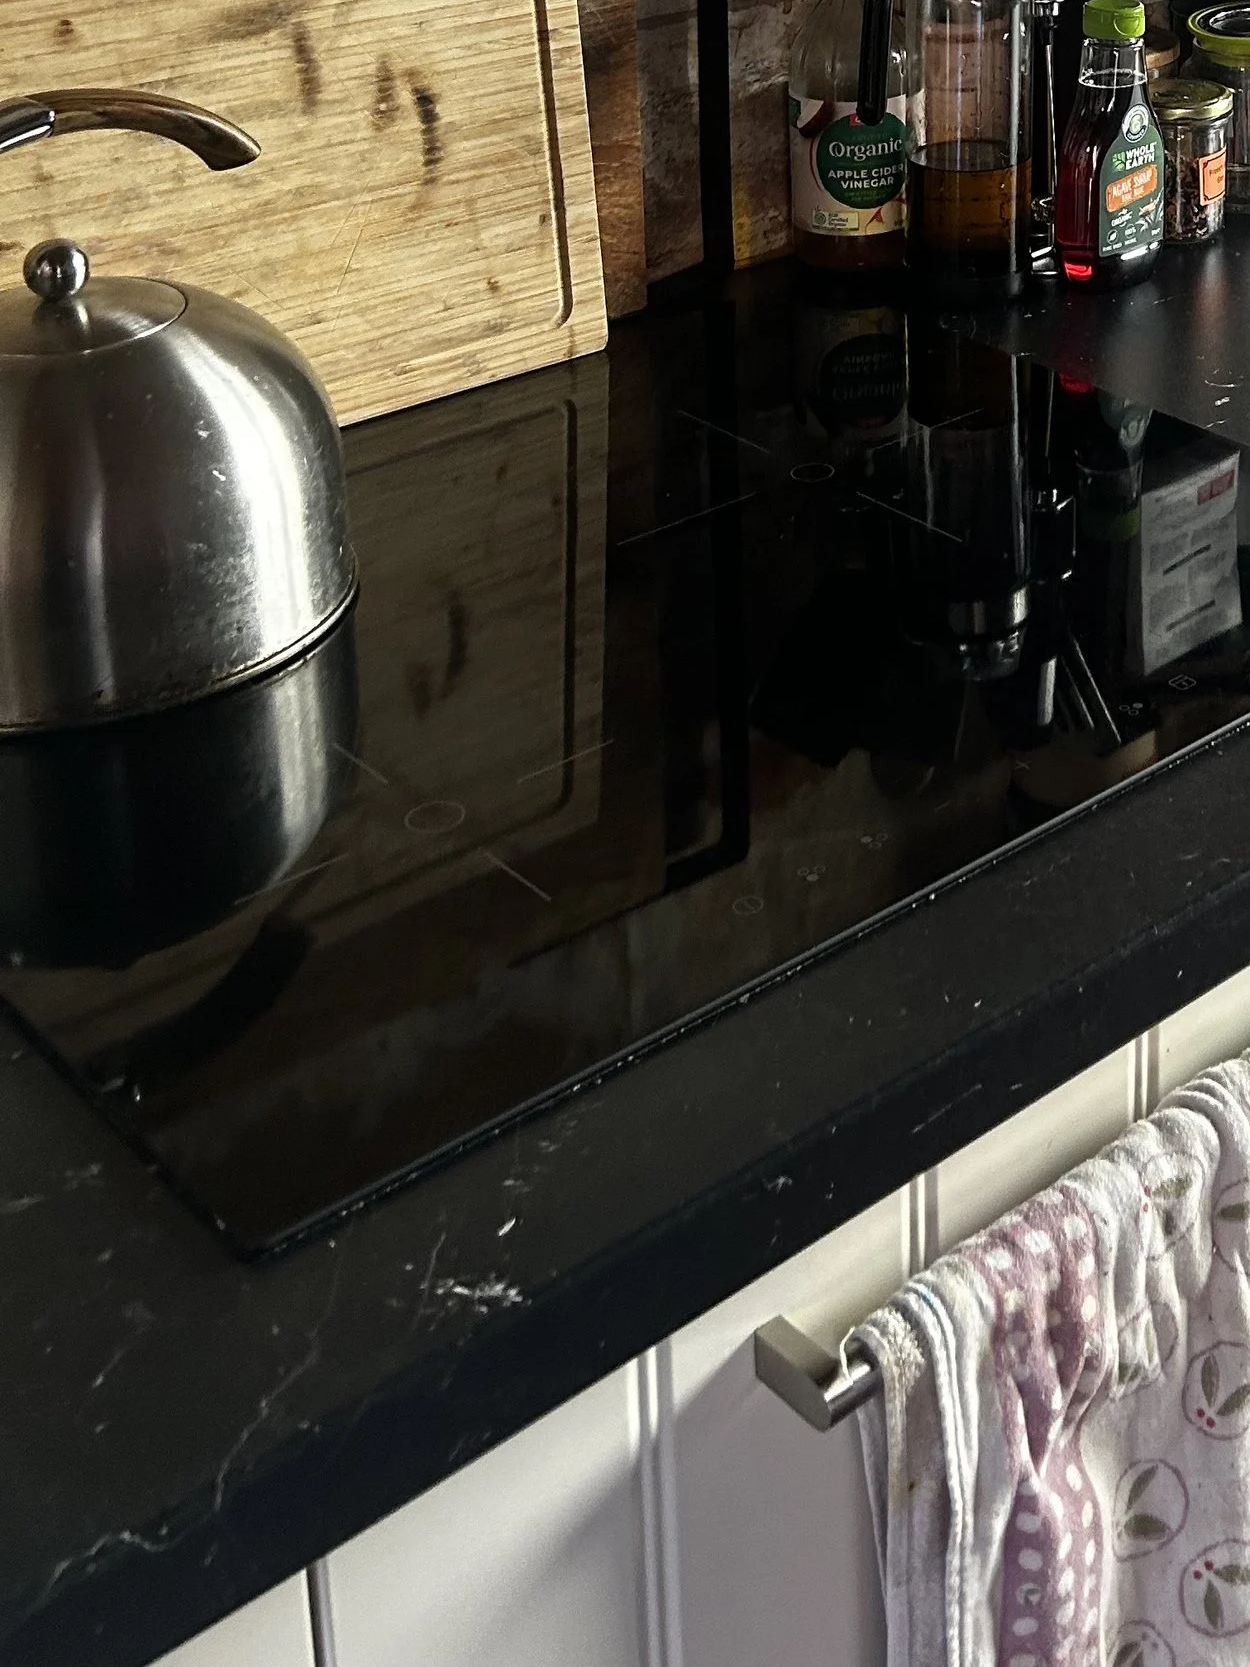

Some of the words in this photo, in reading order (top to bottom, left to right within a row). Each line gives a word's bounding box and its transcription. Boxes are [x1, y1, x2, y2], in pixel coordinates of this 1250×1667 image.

[828, 137, 903, 162] Organic
[1126, 143, 1155, 160] WHOLE
[1126, 152, 1155, 170] EARTH
[827, 169, 868, 179] APPLE
[871, 163, 904, 177] CIDER
[840, 177, 894, 190] VINEGAR
